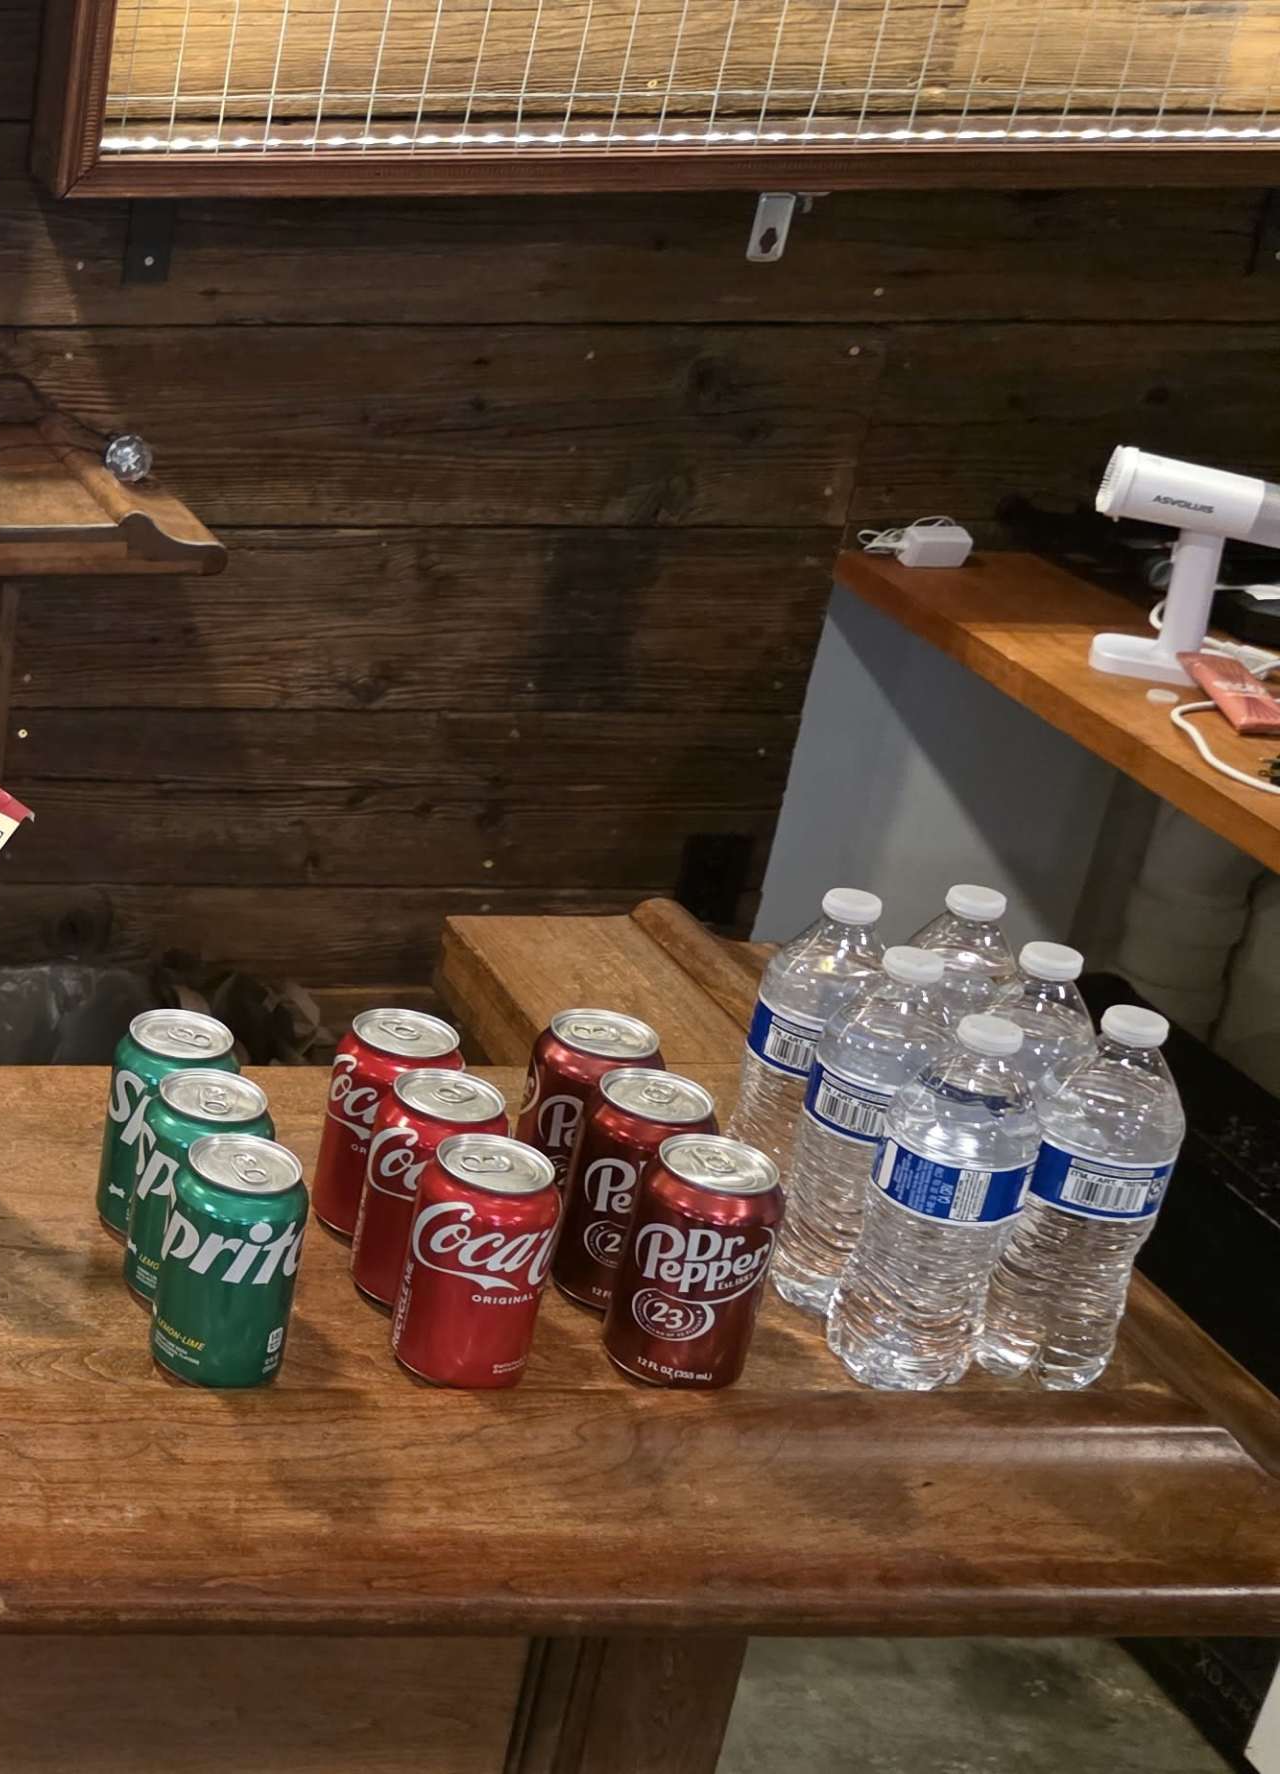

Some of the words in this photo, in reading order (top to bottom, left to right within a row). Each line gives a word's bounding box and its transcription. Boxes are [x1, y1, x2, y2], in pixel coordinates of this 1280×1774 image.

[636, 1223, 770, 1293] Pepper
[685, 1228, 745, 1262] Dr
[472, 1292, 534, 1305] ORIGINAL
[650, 1301, 683, 1329] 23
[637, 1356, 647, 1367] 12
